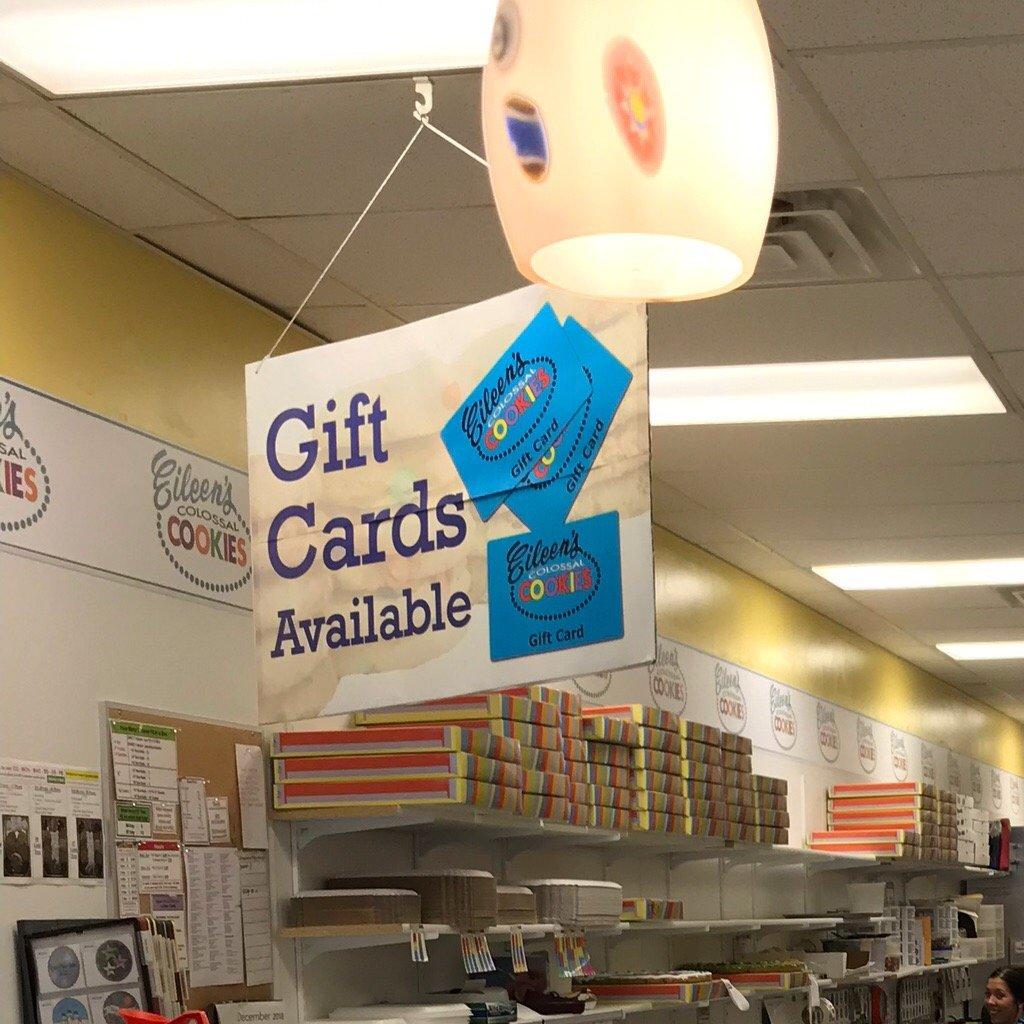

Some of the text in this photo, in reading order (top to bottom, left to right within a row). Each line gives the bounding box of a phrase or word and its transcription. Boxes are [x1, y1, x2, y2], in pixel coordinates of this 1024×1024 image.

[461, 352, 527, 447] Eileen's
[484, 367, 550, 450] COOKIES
[266, 392, 389, 482] Gift
[511, 451, 532, 478] Gift
[532, 418, 559, 452] Card
[566, 419, 604, 494] Gift Card
[151, 449, 238, 516] Eileen's
[168, 515, 248, 568] COOKIES
[177, 506, 239, 531] COLOSSAL
[267, 479, 467, 579] Cards
[506, 529, 584, 585] Eileen's
[528, 560, 584, 580] COLOSSAL
[518, 567, 593, 603] COOKIES
[270, 582, 472, 658] Available
[528, 624, 584, 647] Gift Card
[653, 677, 684, 701] COOKIES
[719, 697, 744, 721] COOKIES
[774, 717, 795, 737] COOKIES
[238, 1011, 271, 1022] December
